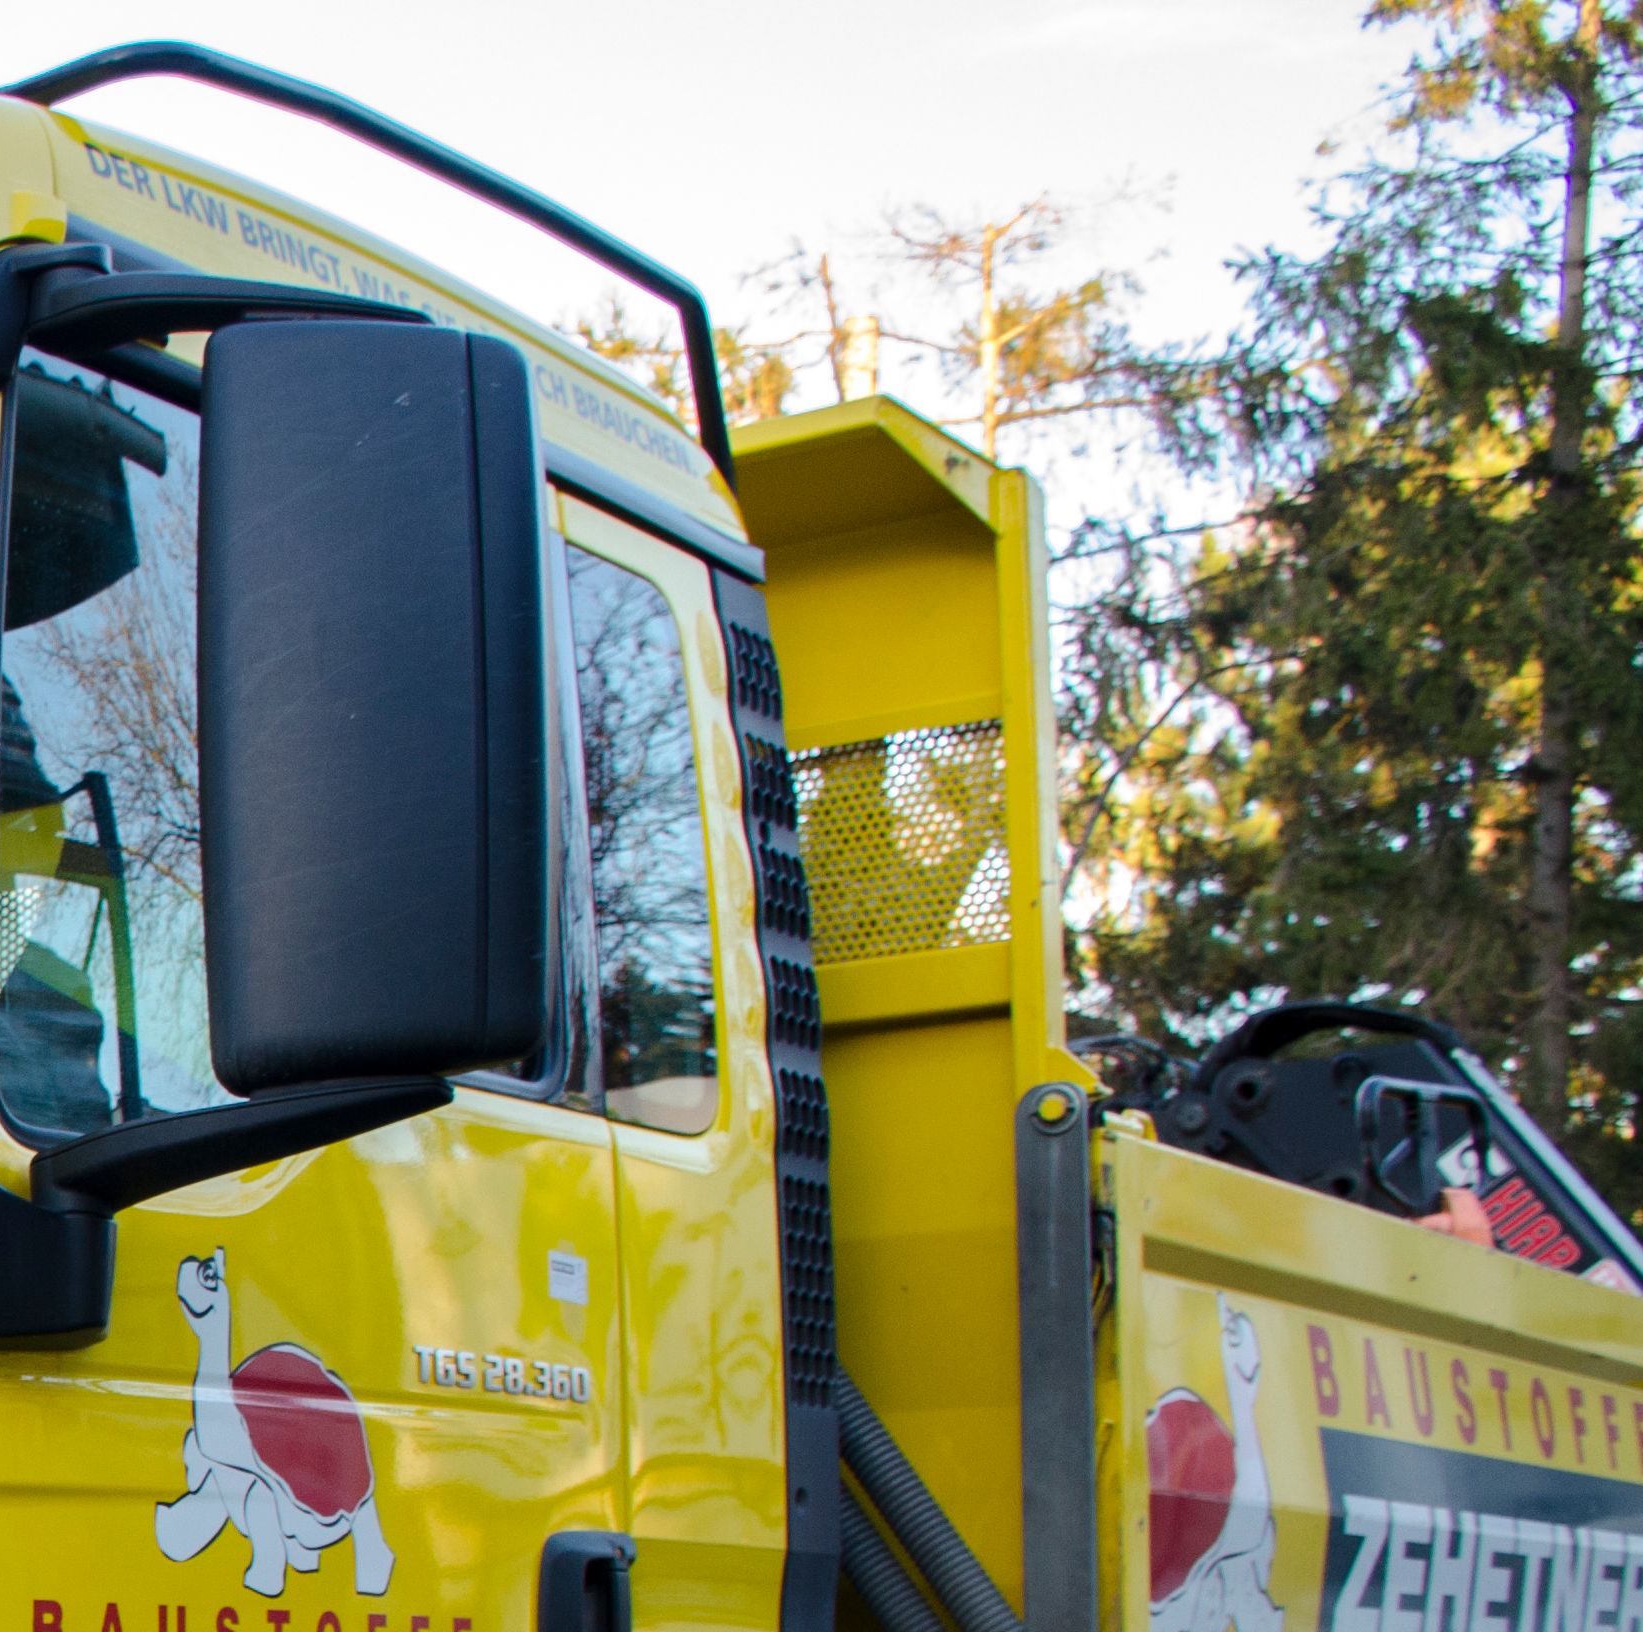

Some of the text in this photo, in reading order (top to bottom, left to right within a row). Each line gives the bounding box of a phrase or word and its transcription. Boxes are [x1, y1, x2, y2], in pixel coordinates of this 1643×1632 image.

[83, 141, 157, 200] DER
[160, 174, 229, 235] LKW
[412, 1343, 590, 1404] TGS 28.360
